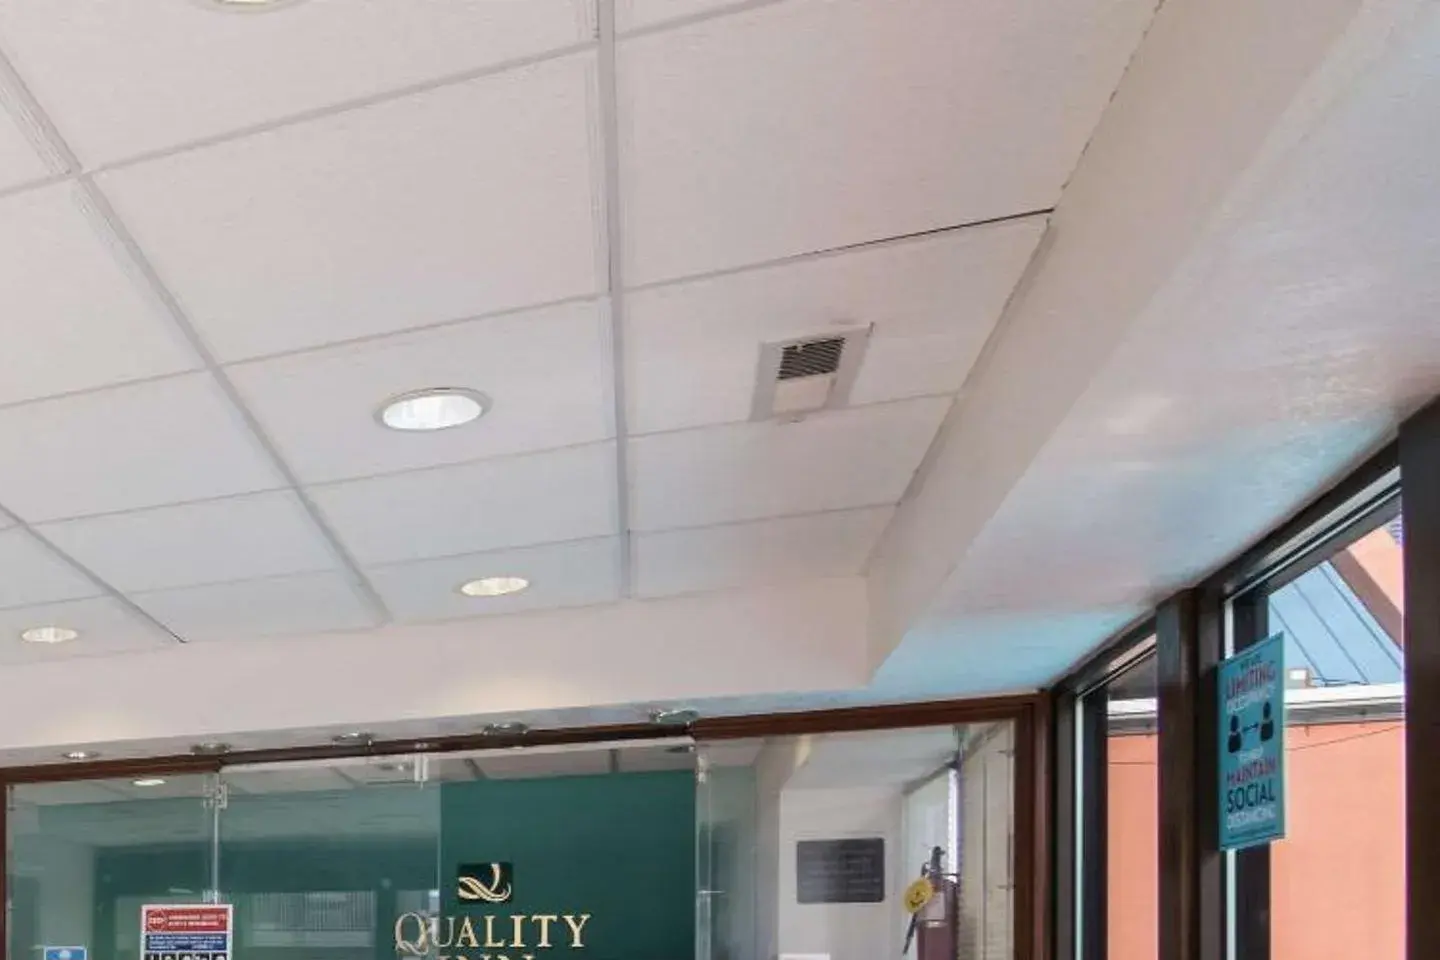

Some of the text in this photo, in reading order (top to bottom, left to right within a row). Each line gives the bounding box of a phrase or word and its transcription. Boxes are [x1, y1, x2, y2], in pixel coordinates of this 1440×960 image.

[1226, 661, 1276, 698] LIMITING
[1226, 757, 1276, 785] MAINTAIN
[1227, 779, 1276, 813] SOCIAL
[394, 911, 591, 956] QUALITY
